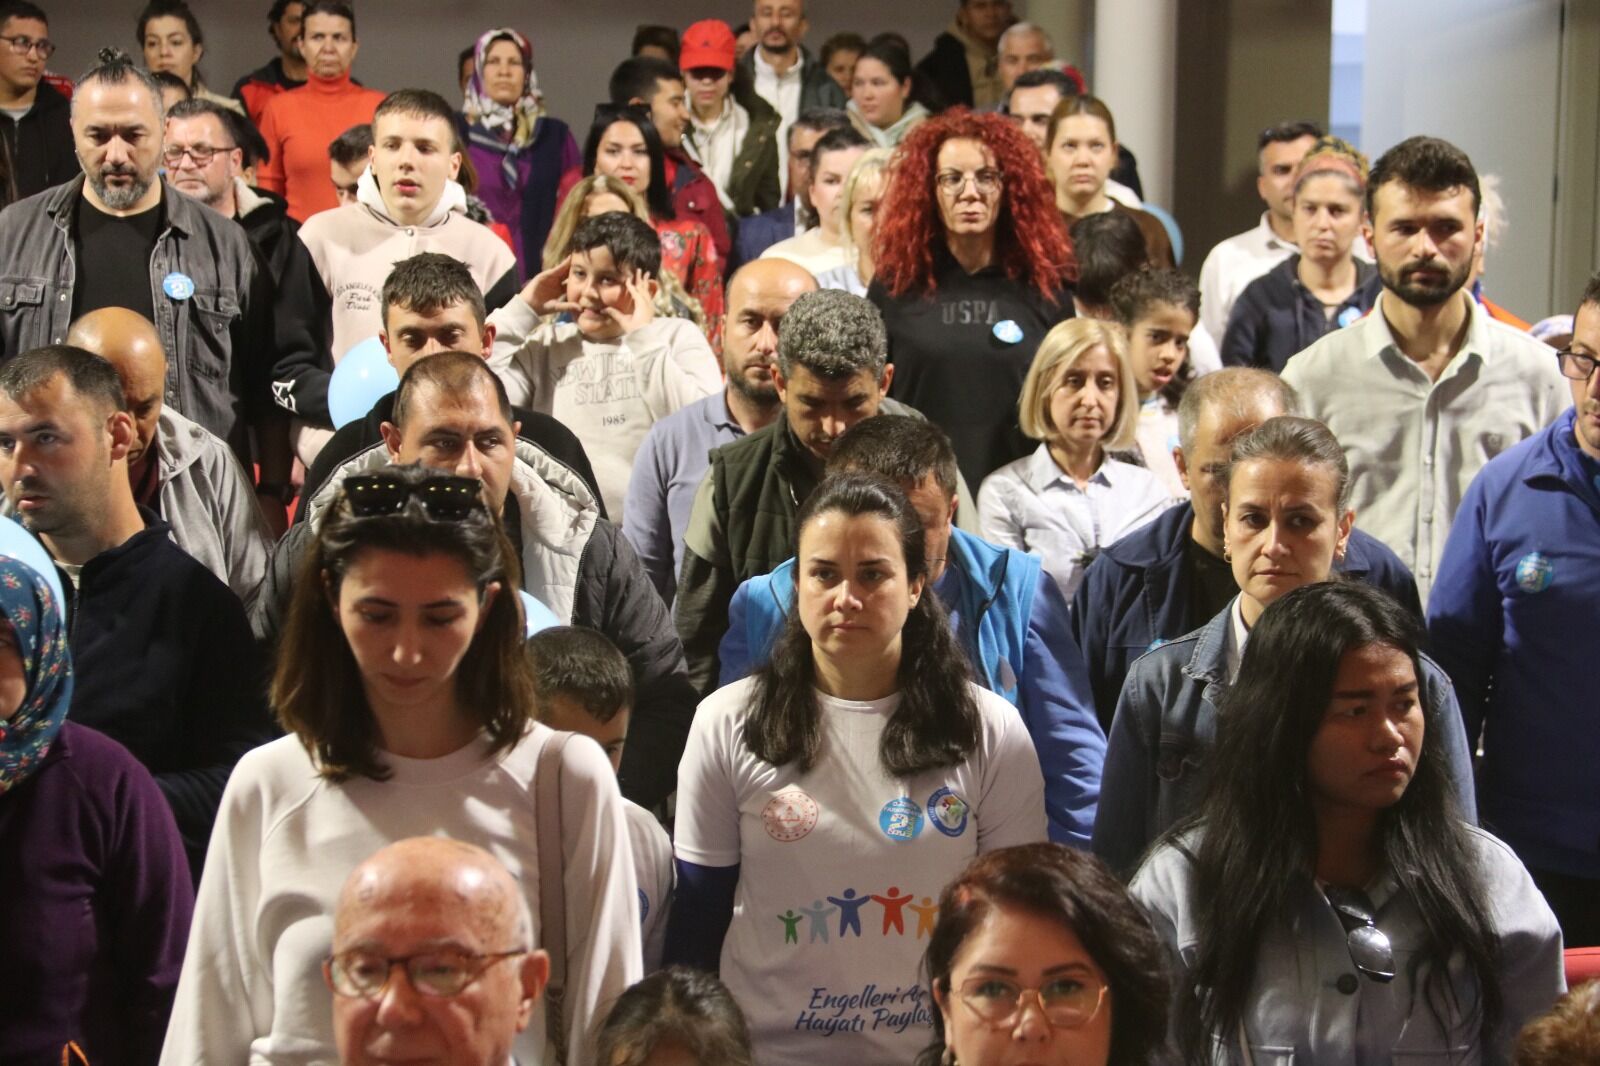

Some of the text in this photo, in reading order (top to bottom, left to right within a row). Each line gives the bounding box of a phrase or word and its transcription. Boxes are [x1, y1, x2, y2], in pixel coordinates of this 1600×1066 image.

[941, 300, 1000, 325] USPA
[602, 415, 626, 426] 1985
[809, 984, 899, 1017] Engelleri
[795, 1010, 865, 1037] Hayatı
